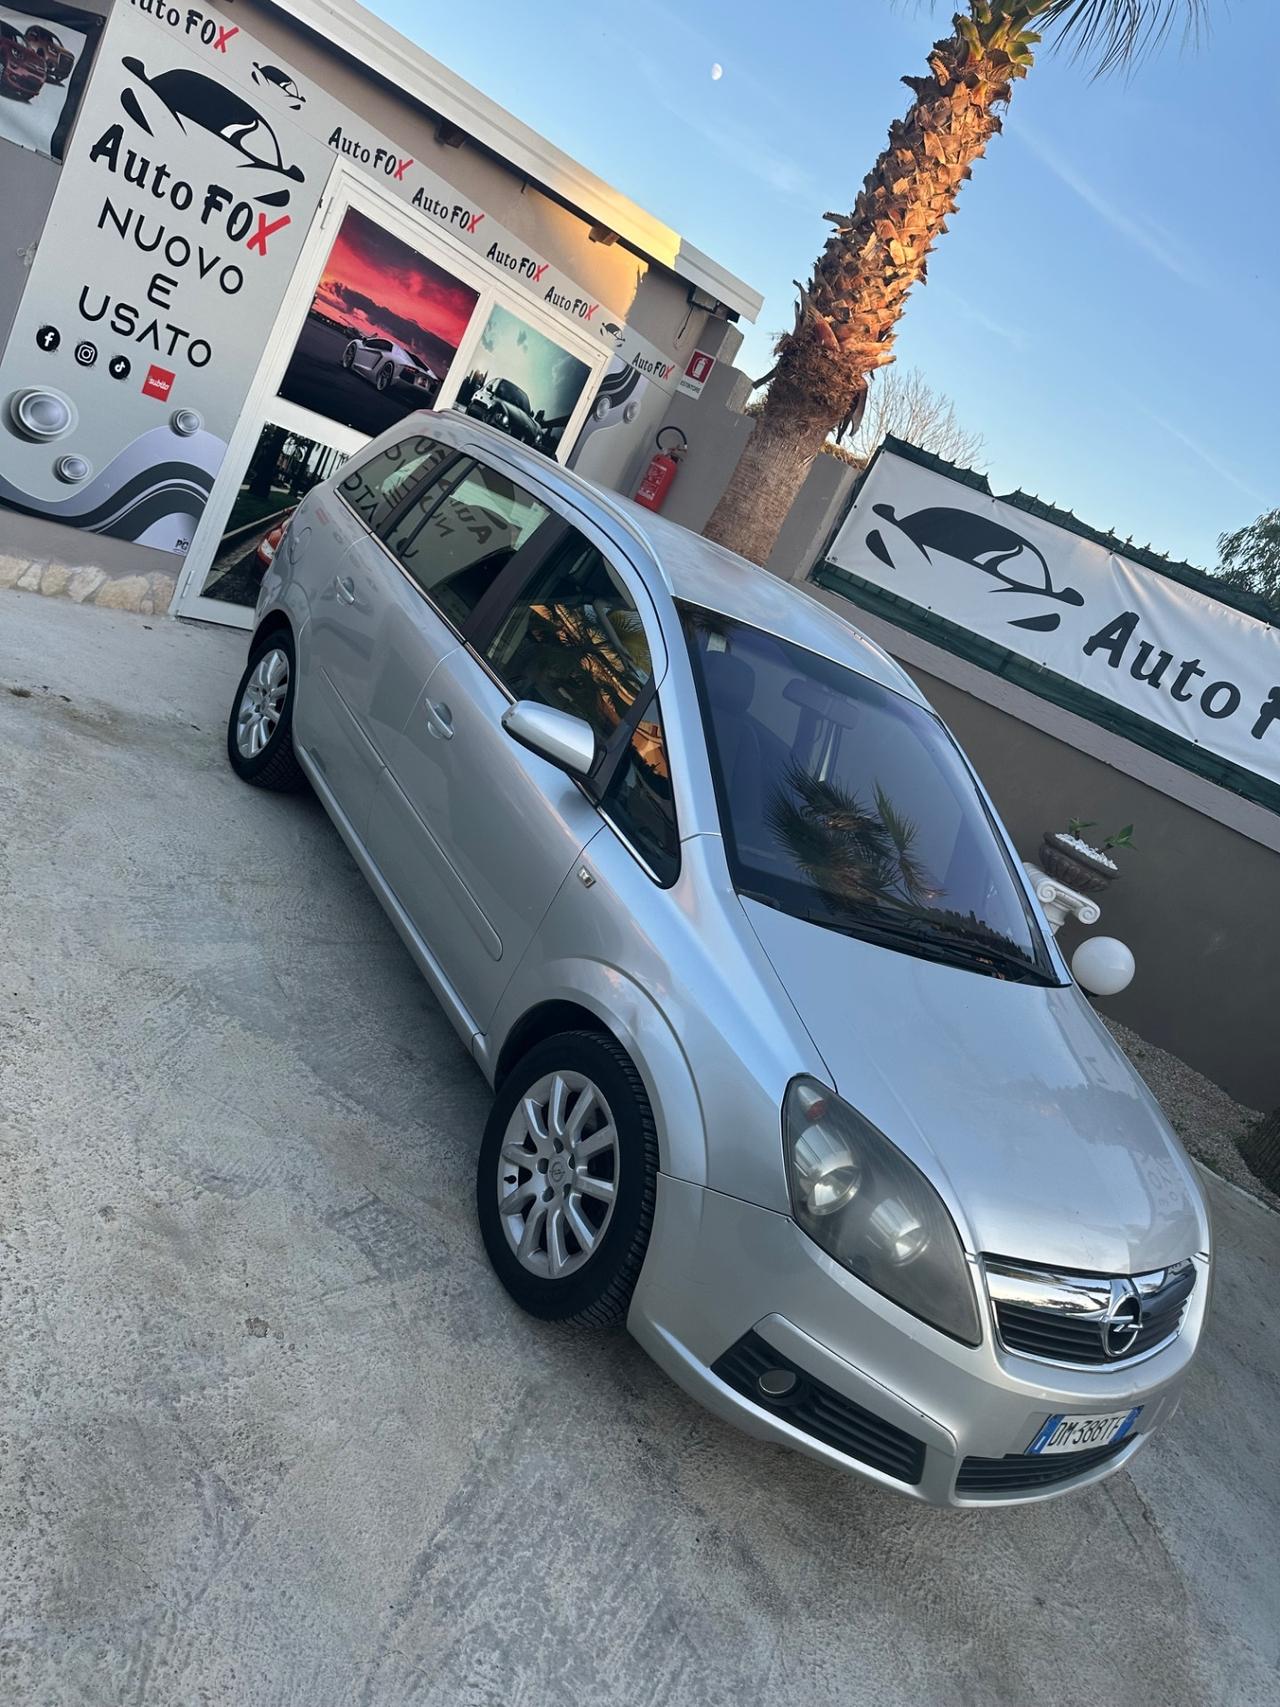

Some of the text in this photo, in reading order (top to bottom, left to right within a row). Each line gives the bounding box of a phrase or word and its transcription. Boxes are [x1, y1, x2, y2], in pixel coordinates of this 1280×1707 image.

[131, 0, 240, 53] uto FOX
[327, 126, 415, 182] Auto FOX
[89, 123, 291, 257] Auto FOX
[411, 187, 486, 234] Auto FOX
[97, 196, 244, 295] NUOVO
[486, 241, 549, 283] Auto FOX
[147, 273, 179, 311] E
[544, 285, 598, 321] Auto FOX
[78, 284, 212, 368] USATO
[631, 351, 676, 381] Auto FOX
[1082, 611, 1241, 719] Auto
